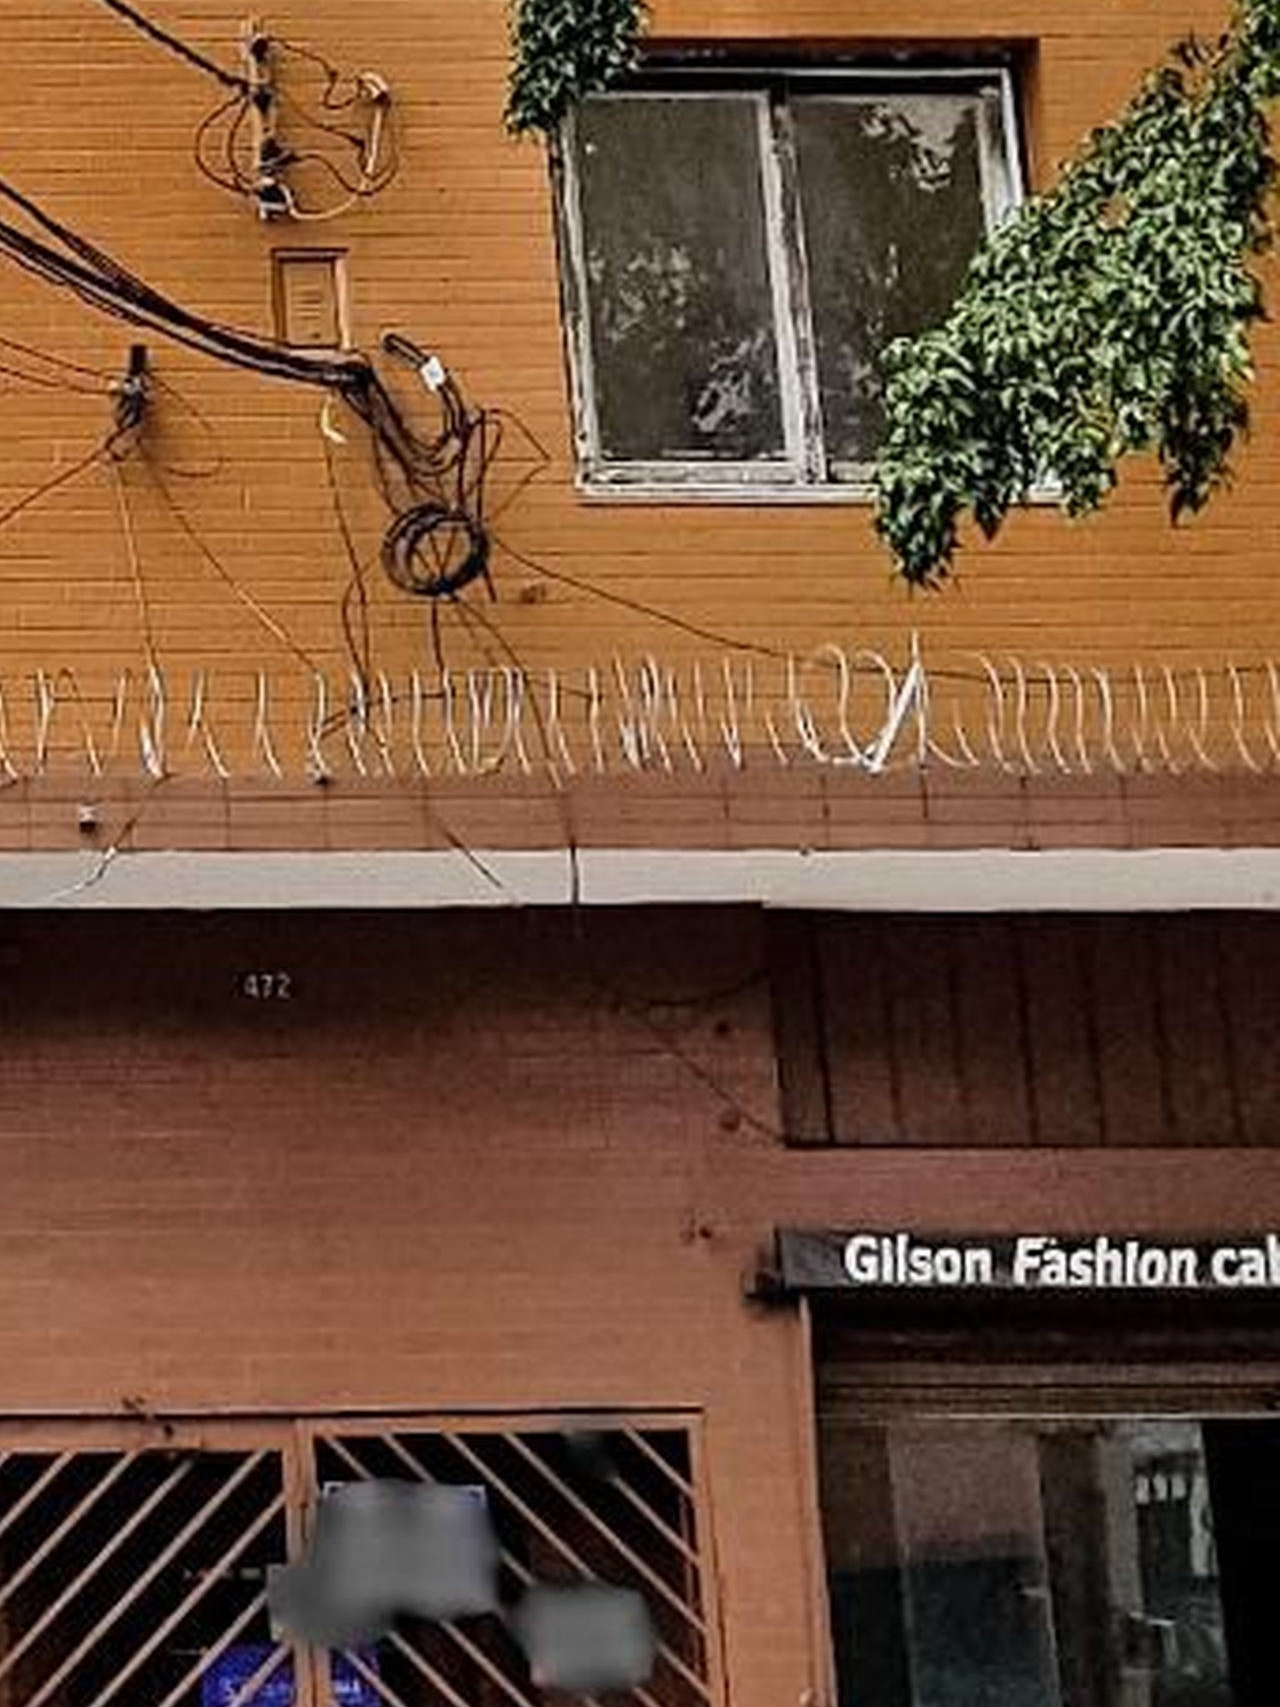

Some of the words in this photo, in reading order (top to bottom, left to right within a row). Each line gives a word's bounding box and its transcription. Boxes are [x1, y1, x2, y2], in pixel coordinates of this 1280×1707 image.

[243, 972, 292, 1000] 472
[843, 1234, 992, 1285] Gilson
[1013, 1235, 1197, 1286] Fashion
